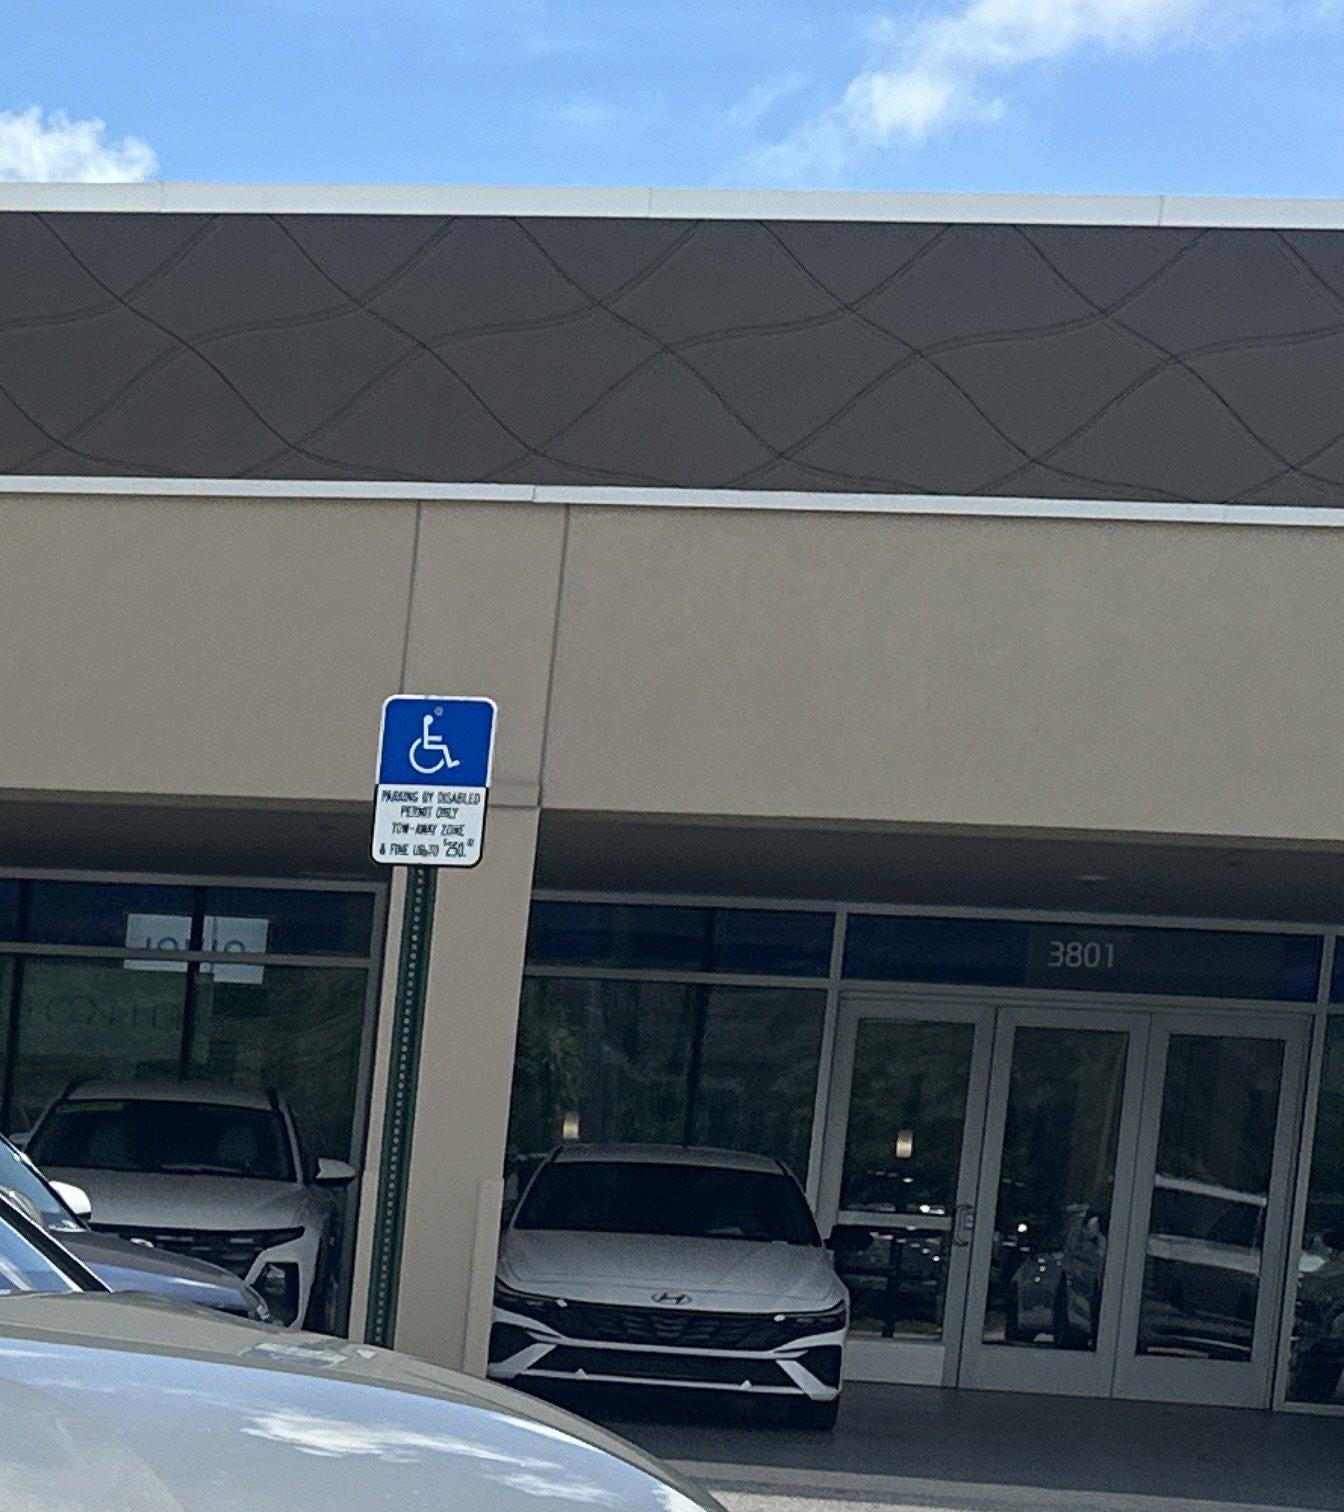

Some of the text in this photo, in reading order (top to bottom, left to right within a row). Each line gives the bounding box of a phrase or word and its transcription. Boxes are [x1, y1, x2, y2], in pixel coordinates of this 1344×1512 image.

[381, 789, 481, 805] PARKING BY DISABLED
[436, 807, 459, 819] ONLY
[392, 822, 465, 837] TOW-AWAY ZONE
[389, 843, 409, 856] FINE
[1047, 941, 1116, 969] 3801
